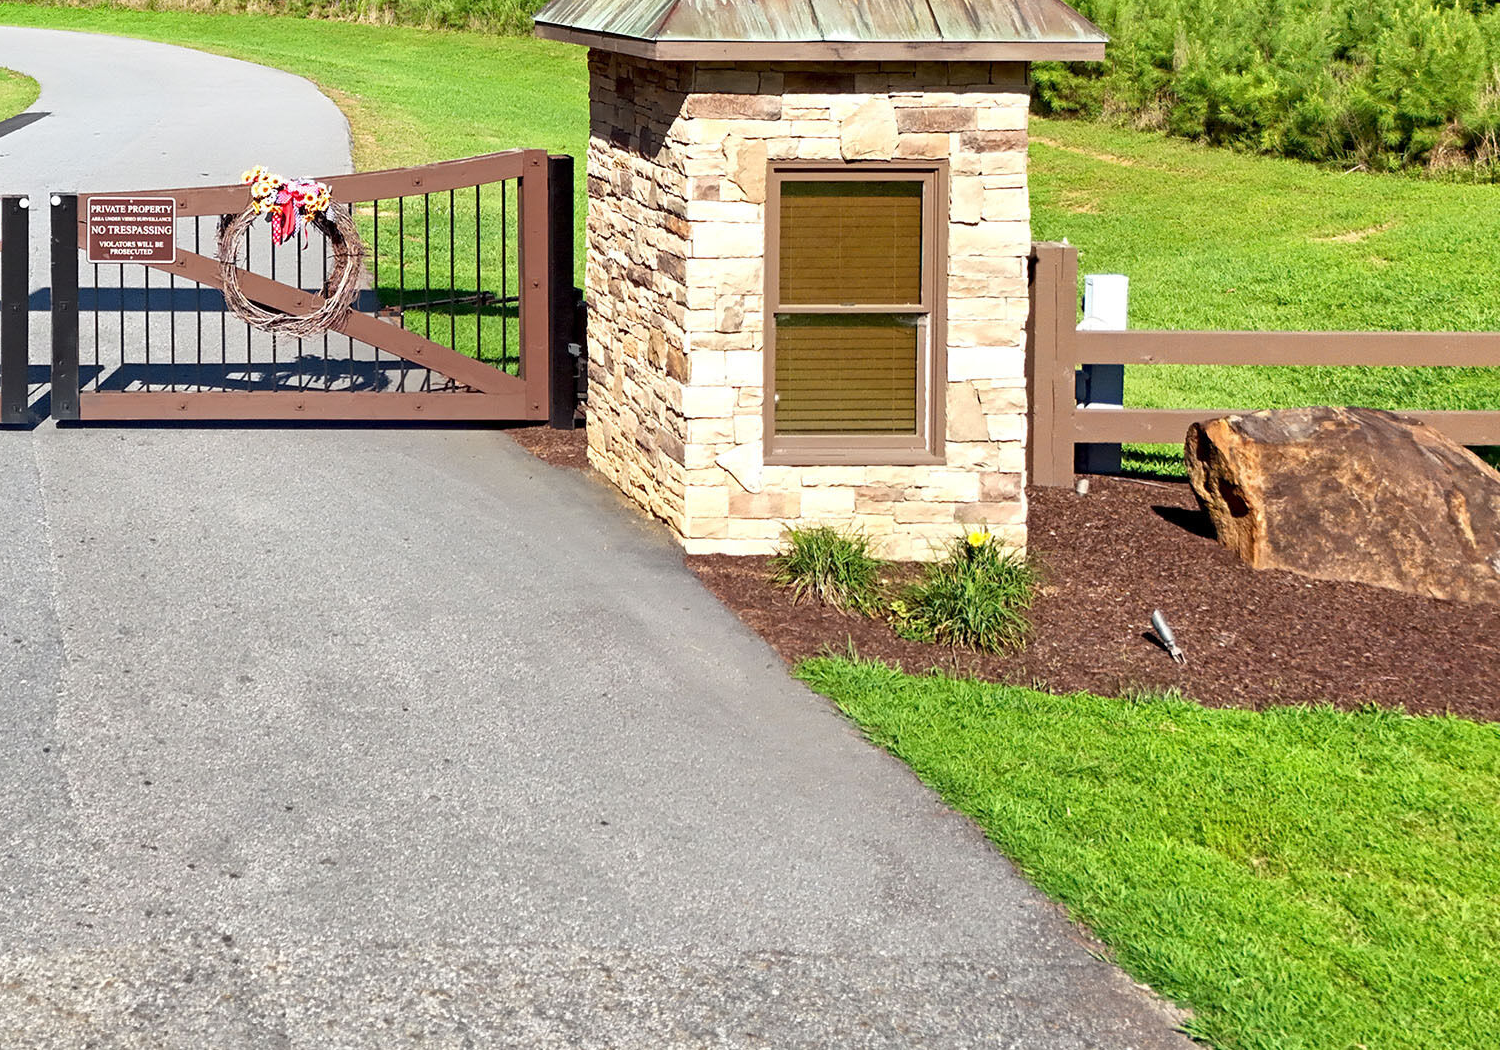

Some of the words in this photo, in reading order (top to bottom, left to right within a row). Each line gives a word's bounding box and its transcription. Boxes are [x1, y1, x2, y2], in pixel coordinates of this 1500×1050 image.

[91, 205, 126, 213] PRIVATE
[127, 205, 172, 213] PROPERTY
[91, 225, 106, 235] NO
[107, 225, 172, 235] TRESPASSING
